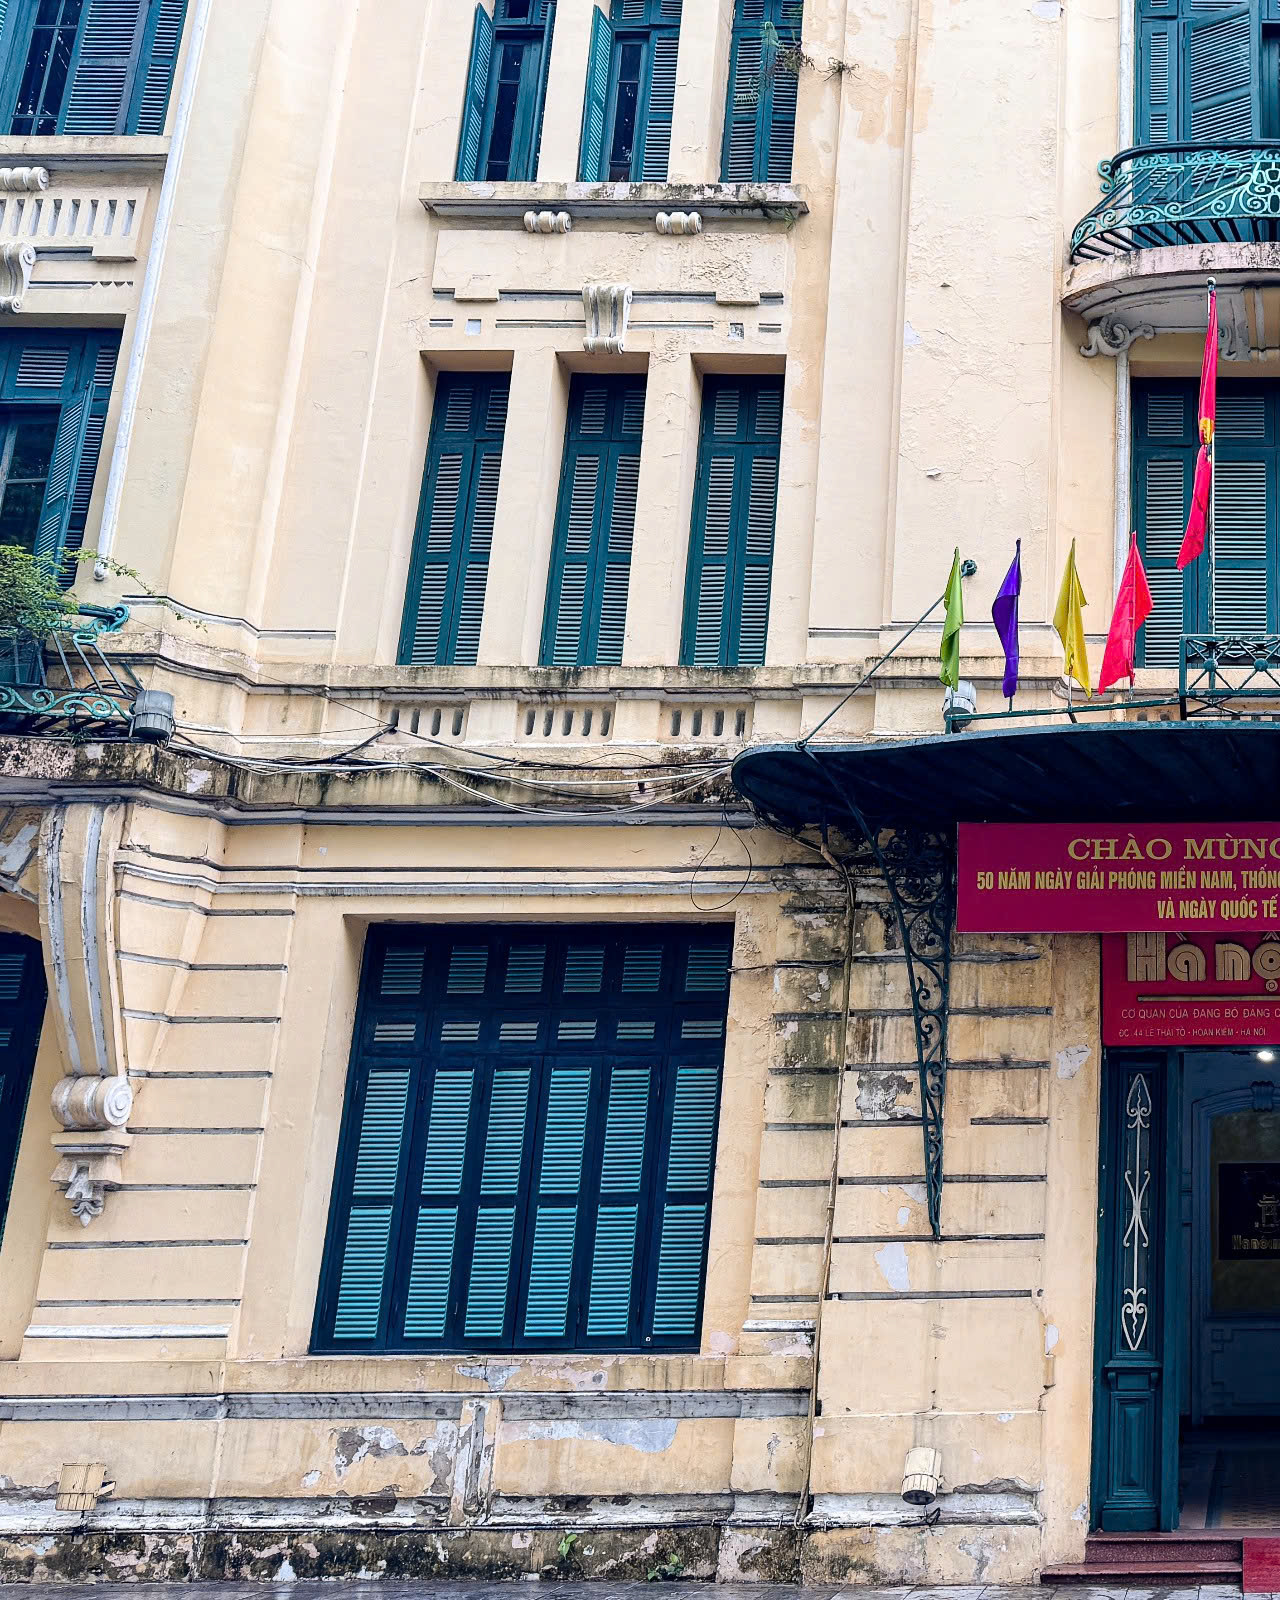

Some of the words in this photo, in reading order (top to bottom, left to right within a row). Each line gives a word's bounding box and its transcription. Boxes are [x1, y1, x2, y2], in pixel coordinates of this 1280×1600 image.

[1068, 833, 1172, 860] CHÀO
[977, 871, 994, 890] 50
[998, 867, 1031, 889] NĂM
[1035, 867, 1072, 889] NGÀY
[1077, 865, 1104, 890] GIẢI
[1109, 867, 1156, 890] PHÓNG
[1160, 864, 1196, 889] MIỀN
[1200, 871, 1237, 891] NAM,
[1157, 897, 1175, 919] VÀ
[1180, 897, 1216, 919] NGÀY
[1220, 893, 1258, 920] QUỐC
[1262, 893, 1278, 918] TẾ
[1139, 1008, 1166, 1020] QUAN
